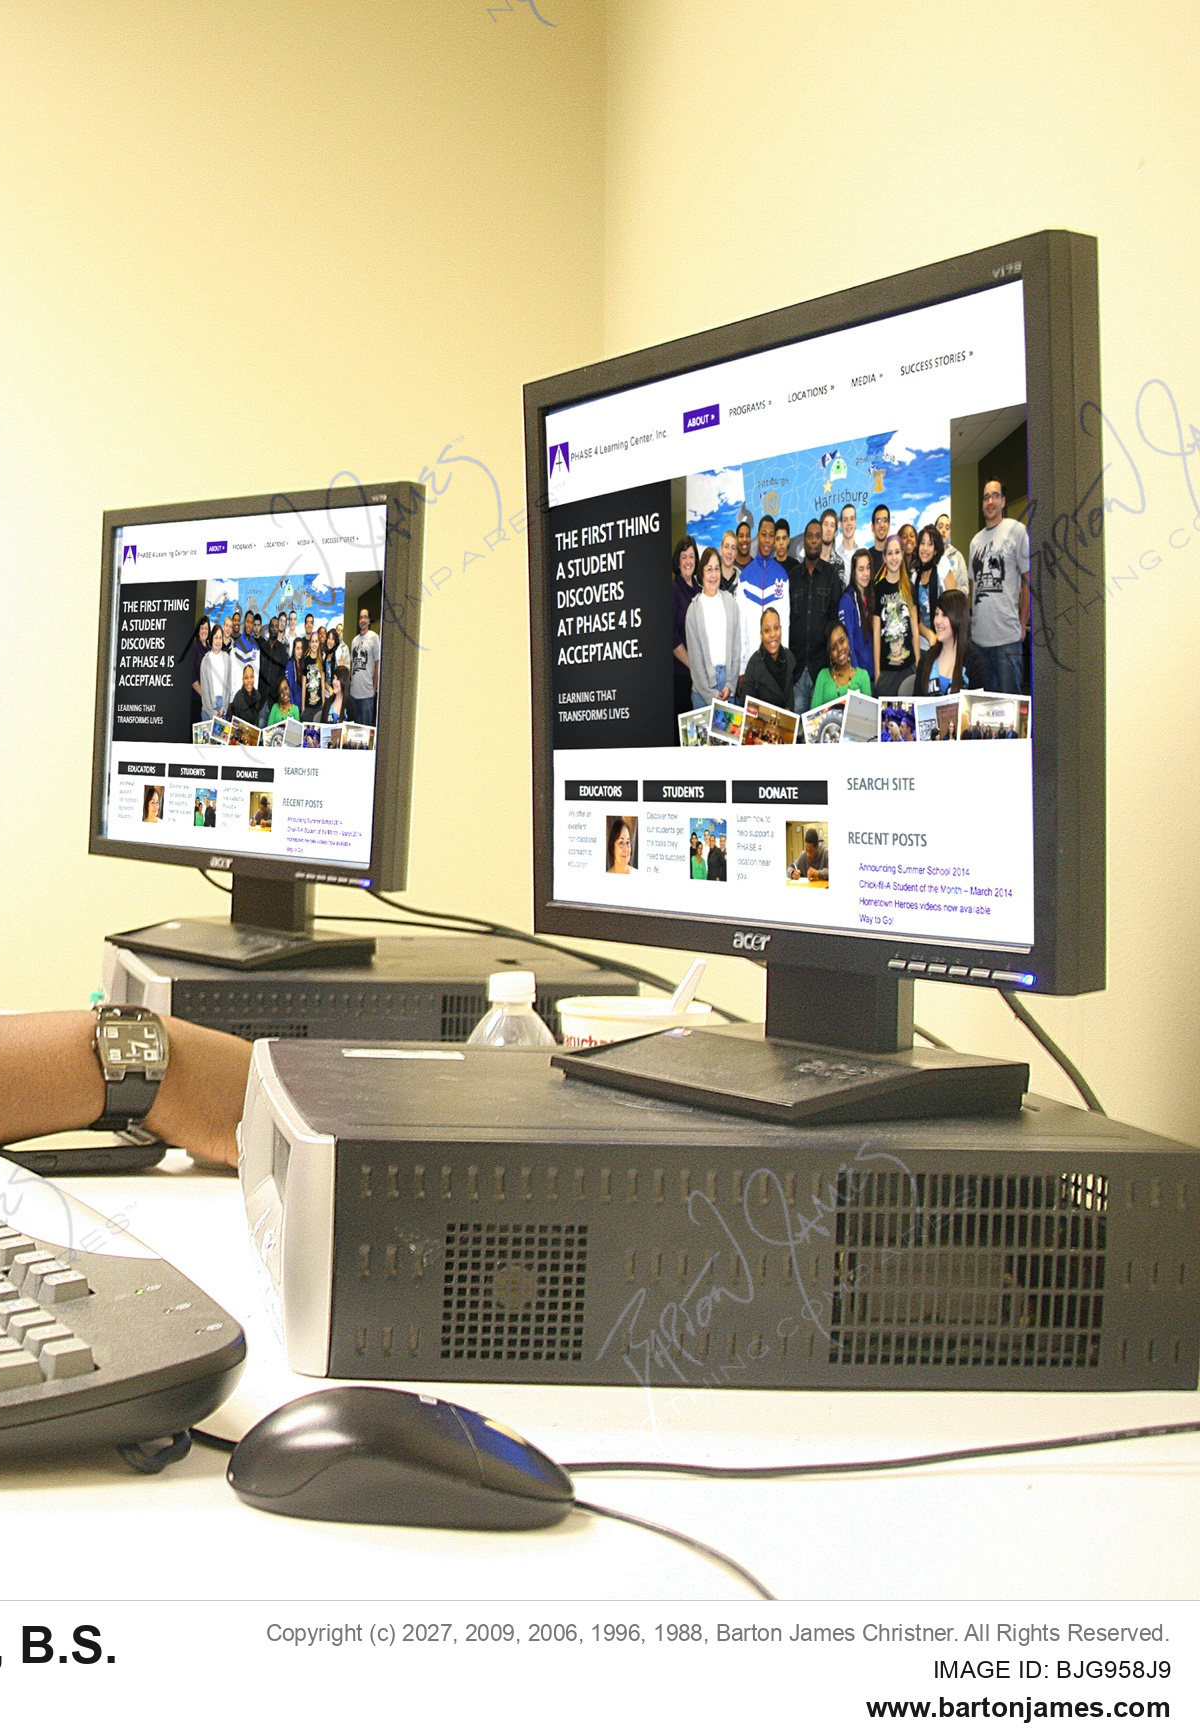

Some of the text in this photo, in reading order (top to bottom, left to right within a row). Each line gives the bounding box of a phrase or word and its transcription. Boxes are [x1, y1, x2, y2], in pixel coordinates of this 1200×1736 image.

[900, 351, 966, 376] SUCCESS STORIES
[851, 373, 876, 388] MEDIA
[788, 385, 828, 403] LOCATIONS
[728, 400, 766, 417] PROGRAMS
[687, 413, 710, 428] ABOUT
[571, 448, 592, 462] PHASE
[594, 446, 599, 456] 4
[600, 439, 629, 455] Learning
[814, 489, 869, 512] Harrisburg
[555, 512, 660, 551] THE FIRST THING
[264, 541, 286, 549] LOCATIONS
[556, 550, 625, 581] A STUDENT
[557, 580, 625, 609] DISCOVERS
[122, 598, 190, 613] THE FIRST THING
[121, 618, 167, 631] A STUDENT
[557, 607, 642, 637] AT PHASE 4 IS
[120, 637, 165, 650] DISCOVERS
[557, 639, 643, 666] ACCEPTANCE.
[119, 655, 175, 668] AT PHASE 4 IS
[118, 674, 174, 687] ACCEPTANCE.
[558, 689, 617, 704] LEARNING THAT
[117, 704, 156, 712] LEARNING THAT
[558, 707, 630, 722] TRANSFORMS LIVES
[117, 716, 164, 725] TRANSFORMS LIVES
[127, 765, 156, 774] EDUCATORS
[180, 767, 206, 777] STUDENTS
[236, 769, 259, 779] DONATE
[284, 766, 319, 776] SEARCH SITE
[579, 785, 622, 797] EDUCATORS
[847, 777, 915, 791] SEARCH SITE
[662, 786, 705, 799] STUDENTS
[758, 786, 799, 800] DONATE
[282, 798, 323, 808] RECENT POSTS
[646, 812, 667, 820] Discover
[655, 826, 675, 834] students
[749, 830, 769, 838] support
[848, 831, 927, 847] RECENT POSTS
[737, 843, 756, 851] PHASE
[665, 854, 685, 862] succeed
[858, 863, 970, 877] Announcing Summer School 2014
[859, 879, 1013, 897] Chick-fil-A Student of the Month March 2014
[859, 897, 991, 916] Hometown Heroes videos now available
[859, 914, 874, 925] Way
[732, 931, 771, 951] acer
